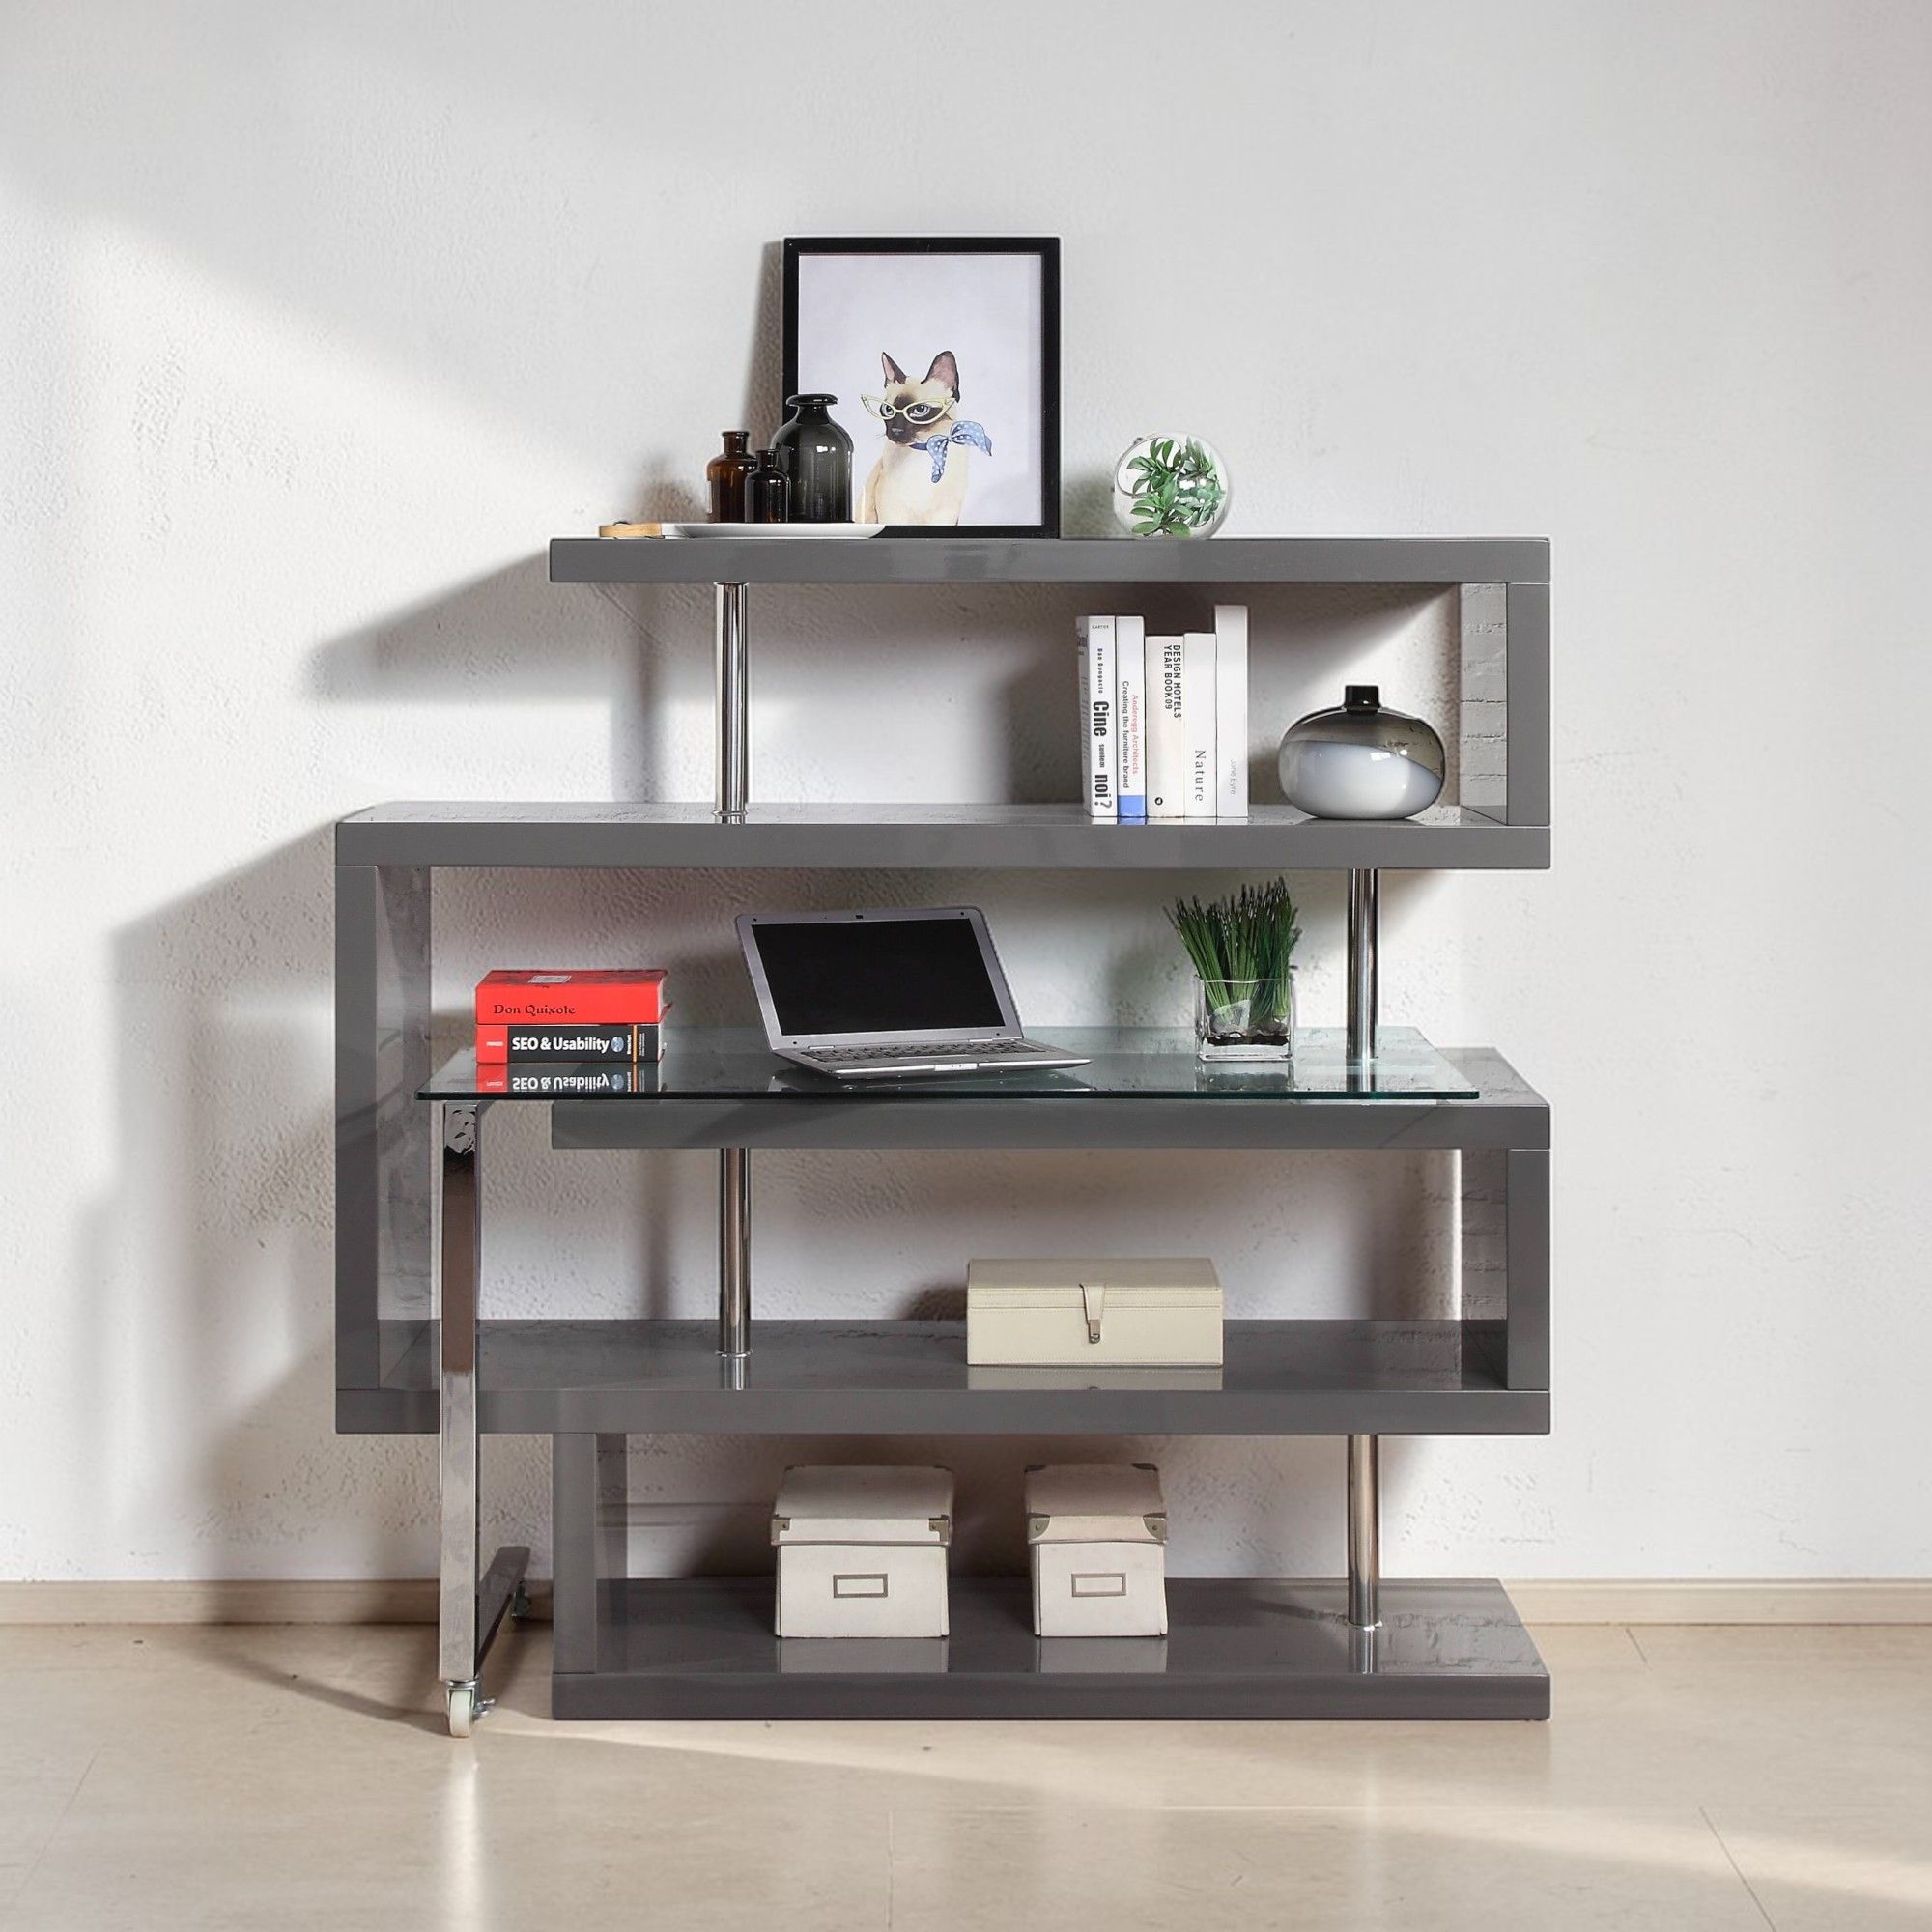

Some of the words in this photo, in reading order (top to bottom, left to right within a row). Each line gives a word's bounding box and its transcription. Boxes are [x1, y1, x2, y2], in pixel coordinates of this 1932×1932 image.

[1163, 644, 1173, 669] YEAR
[1173, 644, 1181, 678] DESIGN
[1121, 680, 1130, 713] Creating
[1130, 695, 1139, 732] Anderegg
[1173, 681, 1182, 718] HOTELS
[1093, 701, 1110, 737] Cine
[1131, 734, 1140, 774] Architects
[1094, 774, 1113, 809] noi?
[1194, 750, 1207, 802] Nature
[494, 1005, 521, 1015] Don
[525, 1005, 576, 1016] Quixote
[512, 1037, 539, 1051] SEO
[540, 1037, 552, 1051] &
[553, 1037, 610, 1054] Usability
